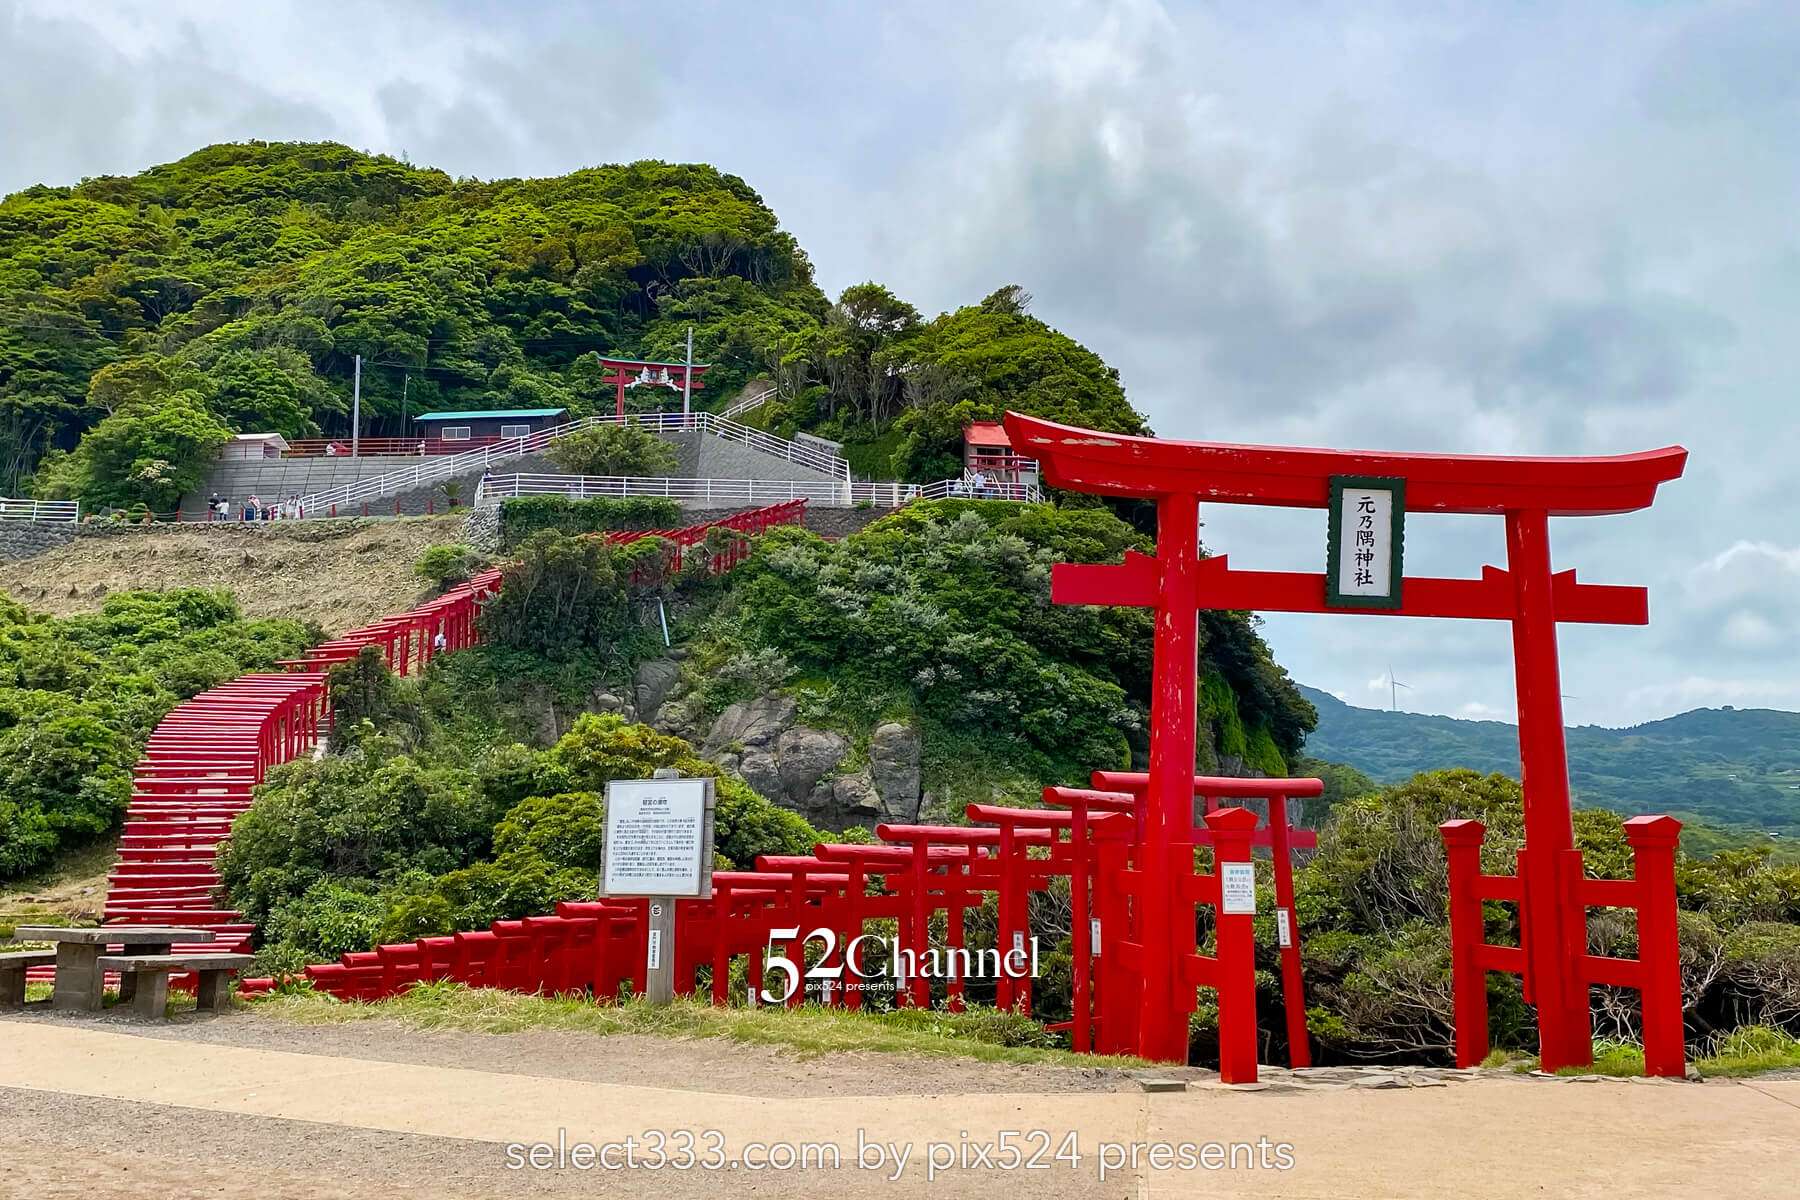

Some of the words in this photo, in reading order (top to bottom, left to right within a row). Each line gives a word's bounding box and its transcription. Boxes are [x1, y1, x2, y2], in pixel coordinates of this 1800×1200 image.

[1354, 496, 1376, 587] 元乃隅神社
